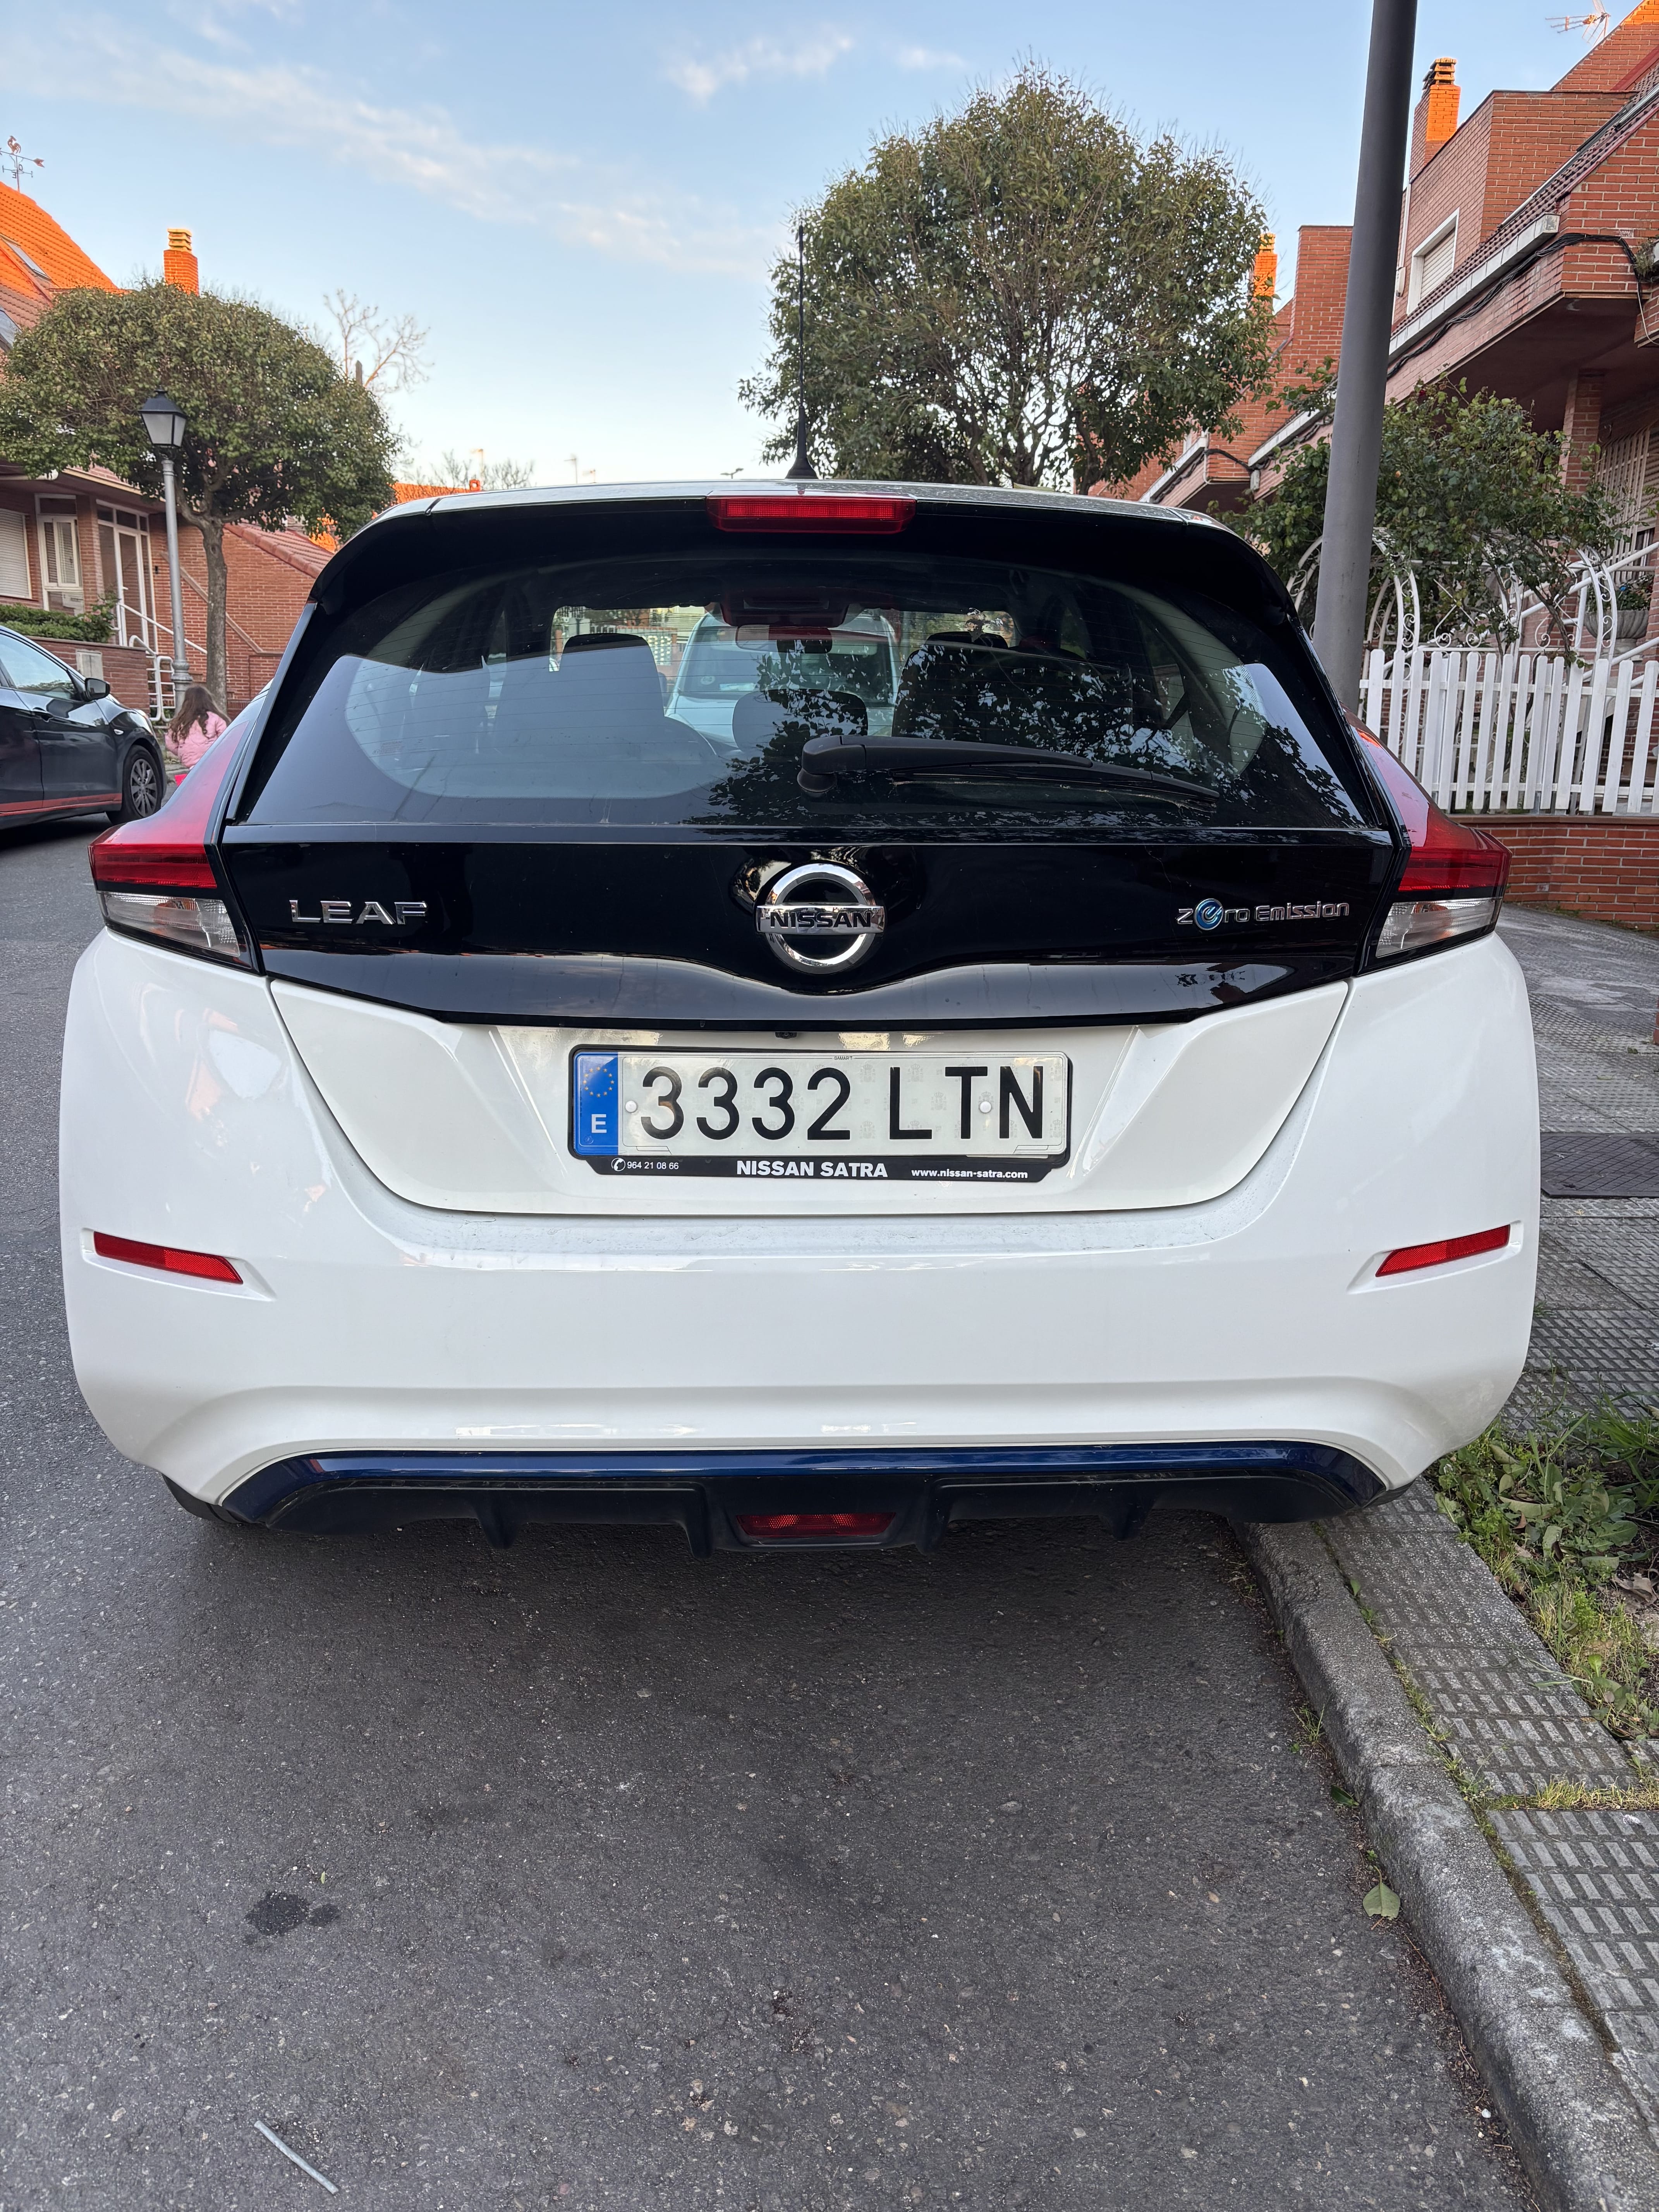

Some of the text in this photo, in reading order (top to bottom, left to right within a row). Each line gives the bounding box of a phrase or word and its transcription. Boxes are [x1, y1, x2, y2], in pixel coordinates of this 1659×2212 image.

[289, 900, 427, 925] LEAF
[770, 912, 871, 928] NISSAN
[1255, 901, 1350, 922] Emission
[641, 1066, 1043, 1140] 3332 LTN
[591, 1114, 607, 1133] E
[737, 1160, 888, 1177] NISSAN SATRA
[911, 1169, 1028, 1178] www.nissan-satra.com
